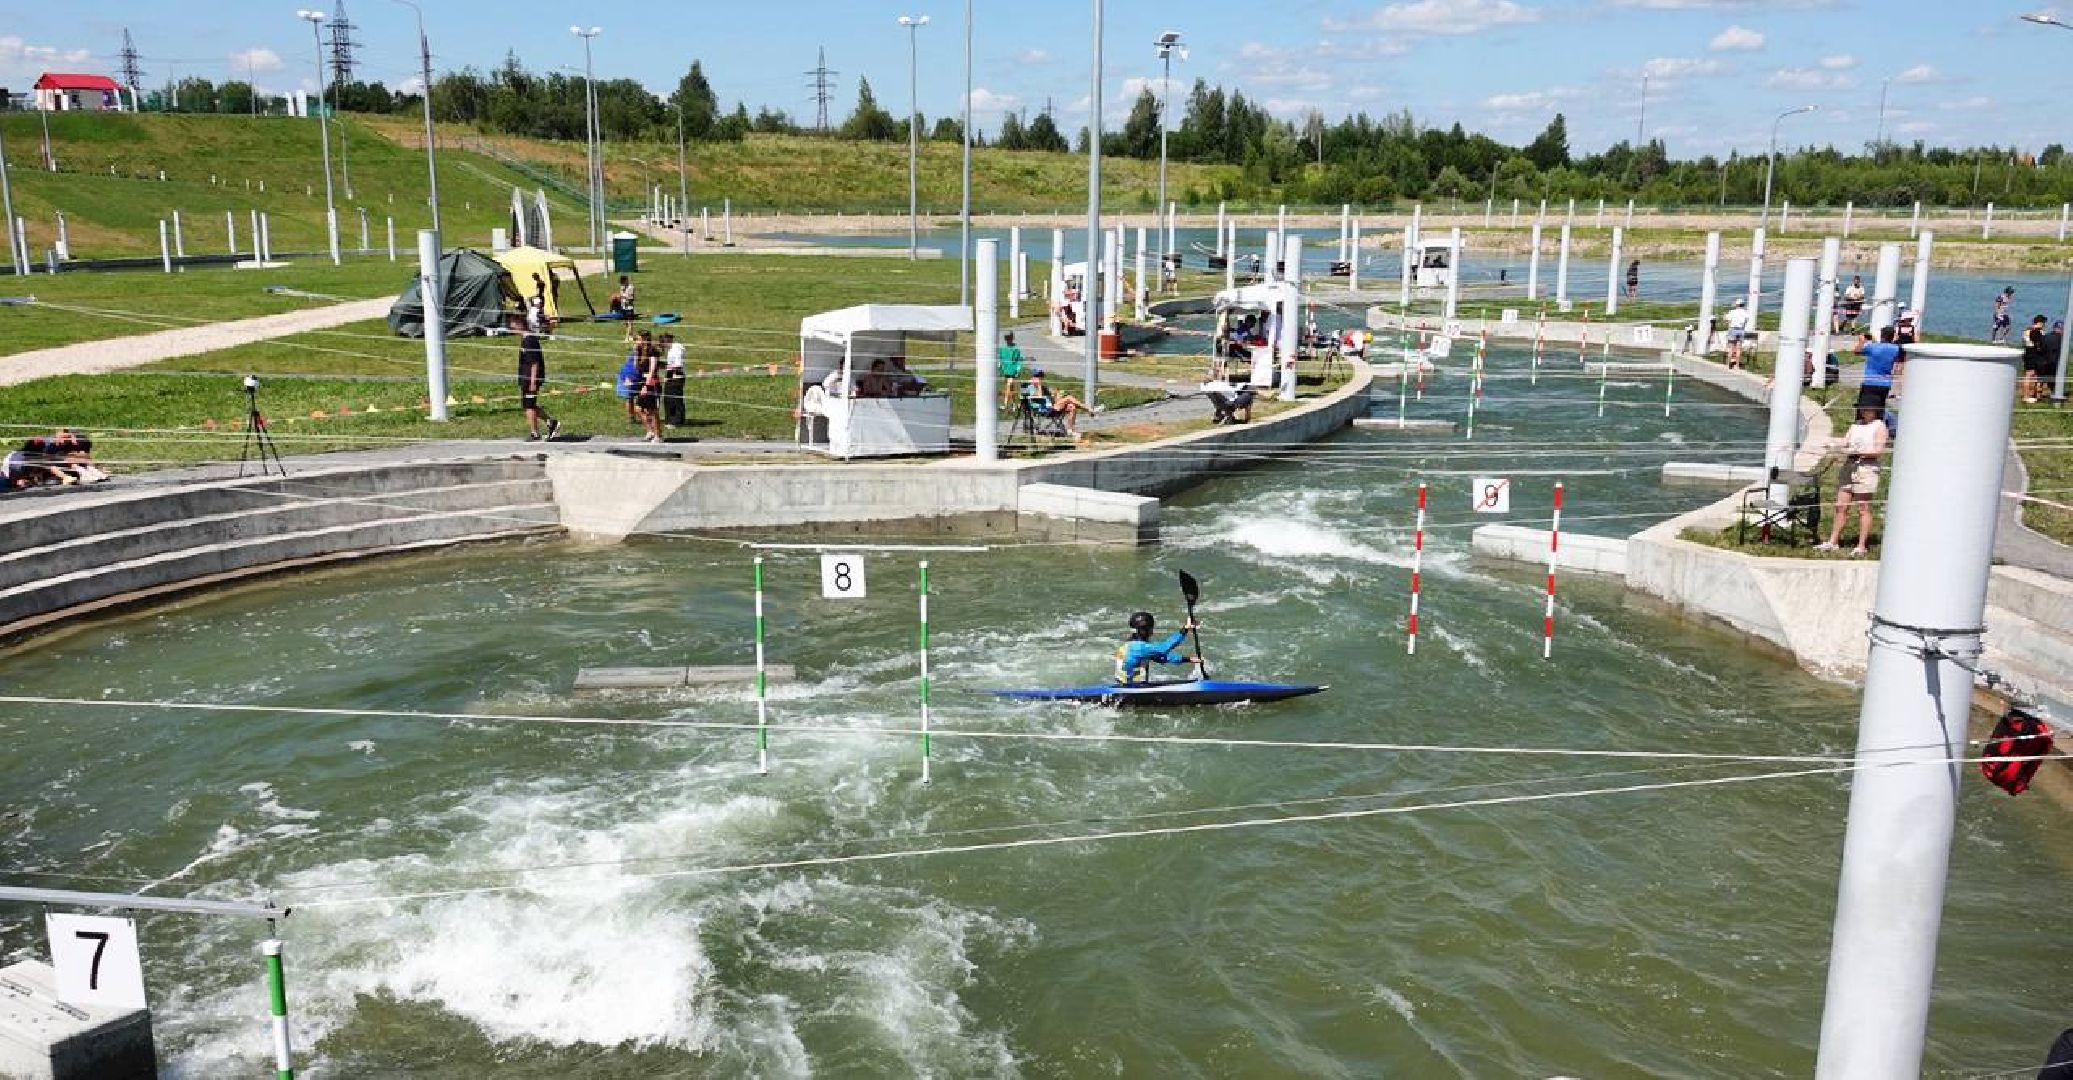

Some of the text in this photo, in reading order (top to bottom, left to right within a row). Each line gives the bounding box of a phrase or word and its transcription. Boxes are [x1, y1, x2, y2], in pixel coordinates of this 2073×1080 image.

[1485, 485, 1498, 506] 9
[835, 562, 851, 591] 8
[75, 931, 109, 990] 7
